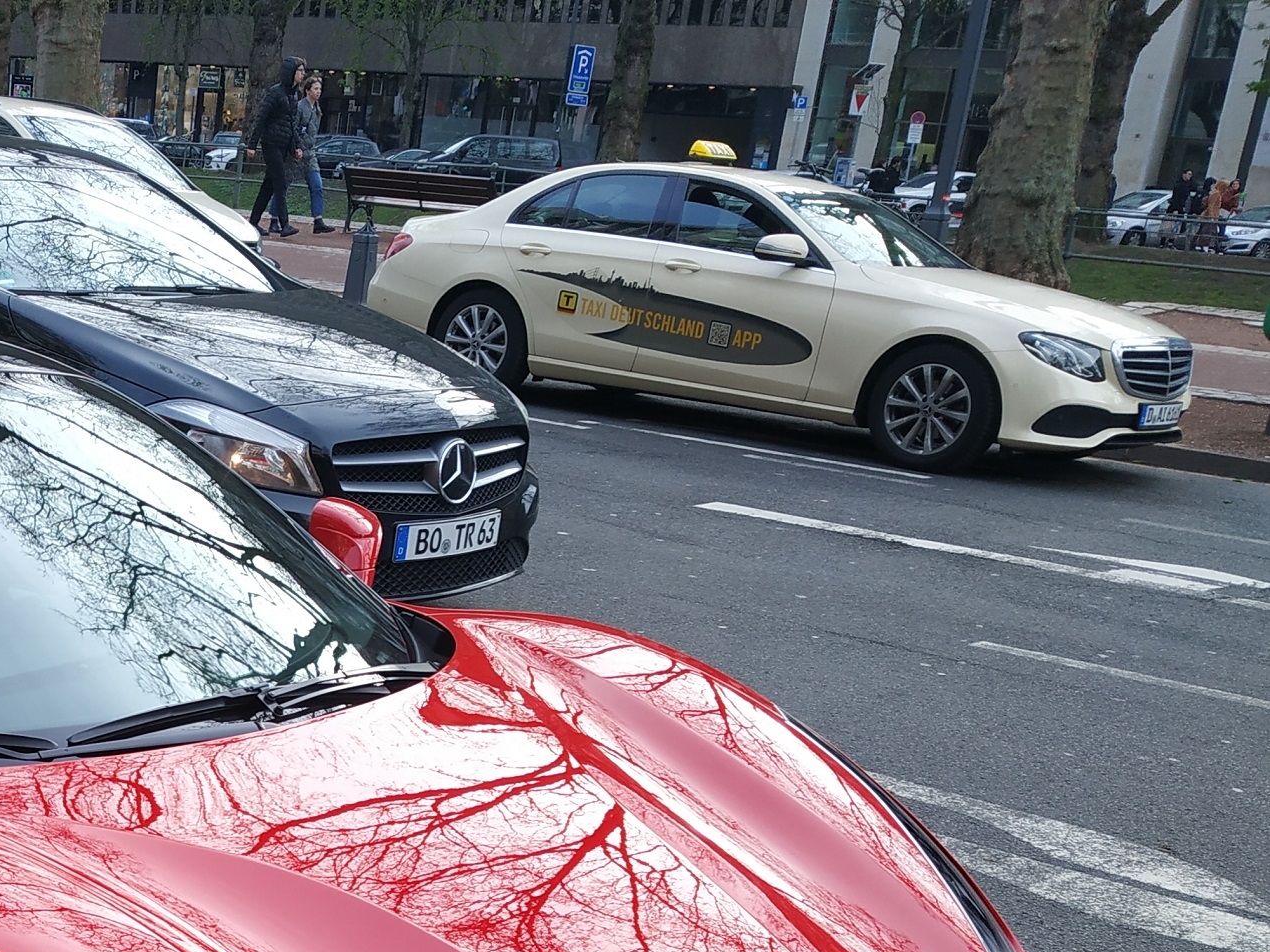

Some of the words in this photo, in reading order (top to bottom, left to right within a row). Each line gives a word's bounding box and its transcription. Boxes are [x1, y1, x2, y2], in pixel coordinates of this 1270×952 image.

[580, 298, 607, 320] TAXI
[610, 304, 705, 340] DEUTSCHLAND
[732, 329, 762, 350] APP
[415, 527, 442, 555] BO
[455, 522, 476, 550] TR
[477, 518, 496, 546] 63
